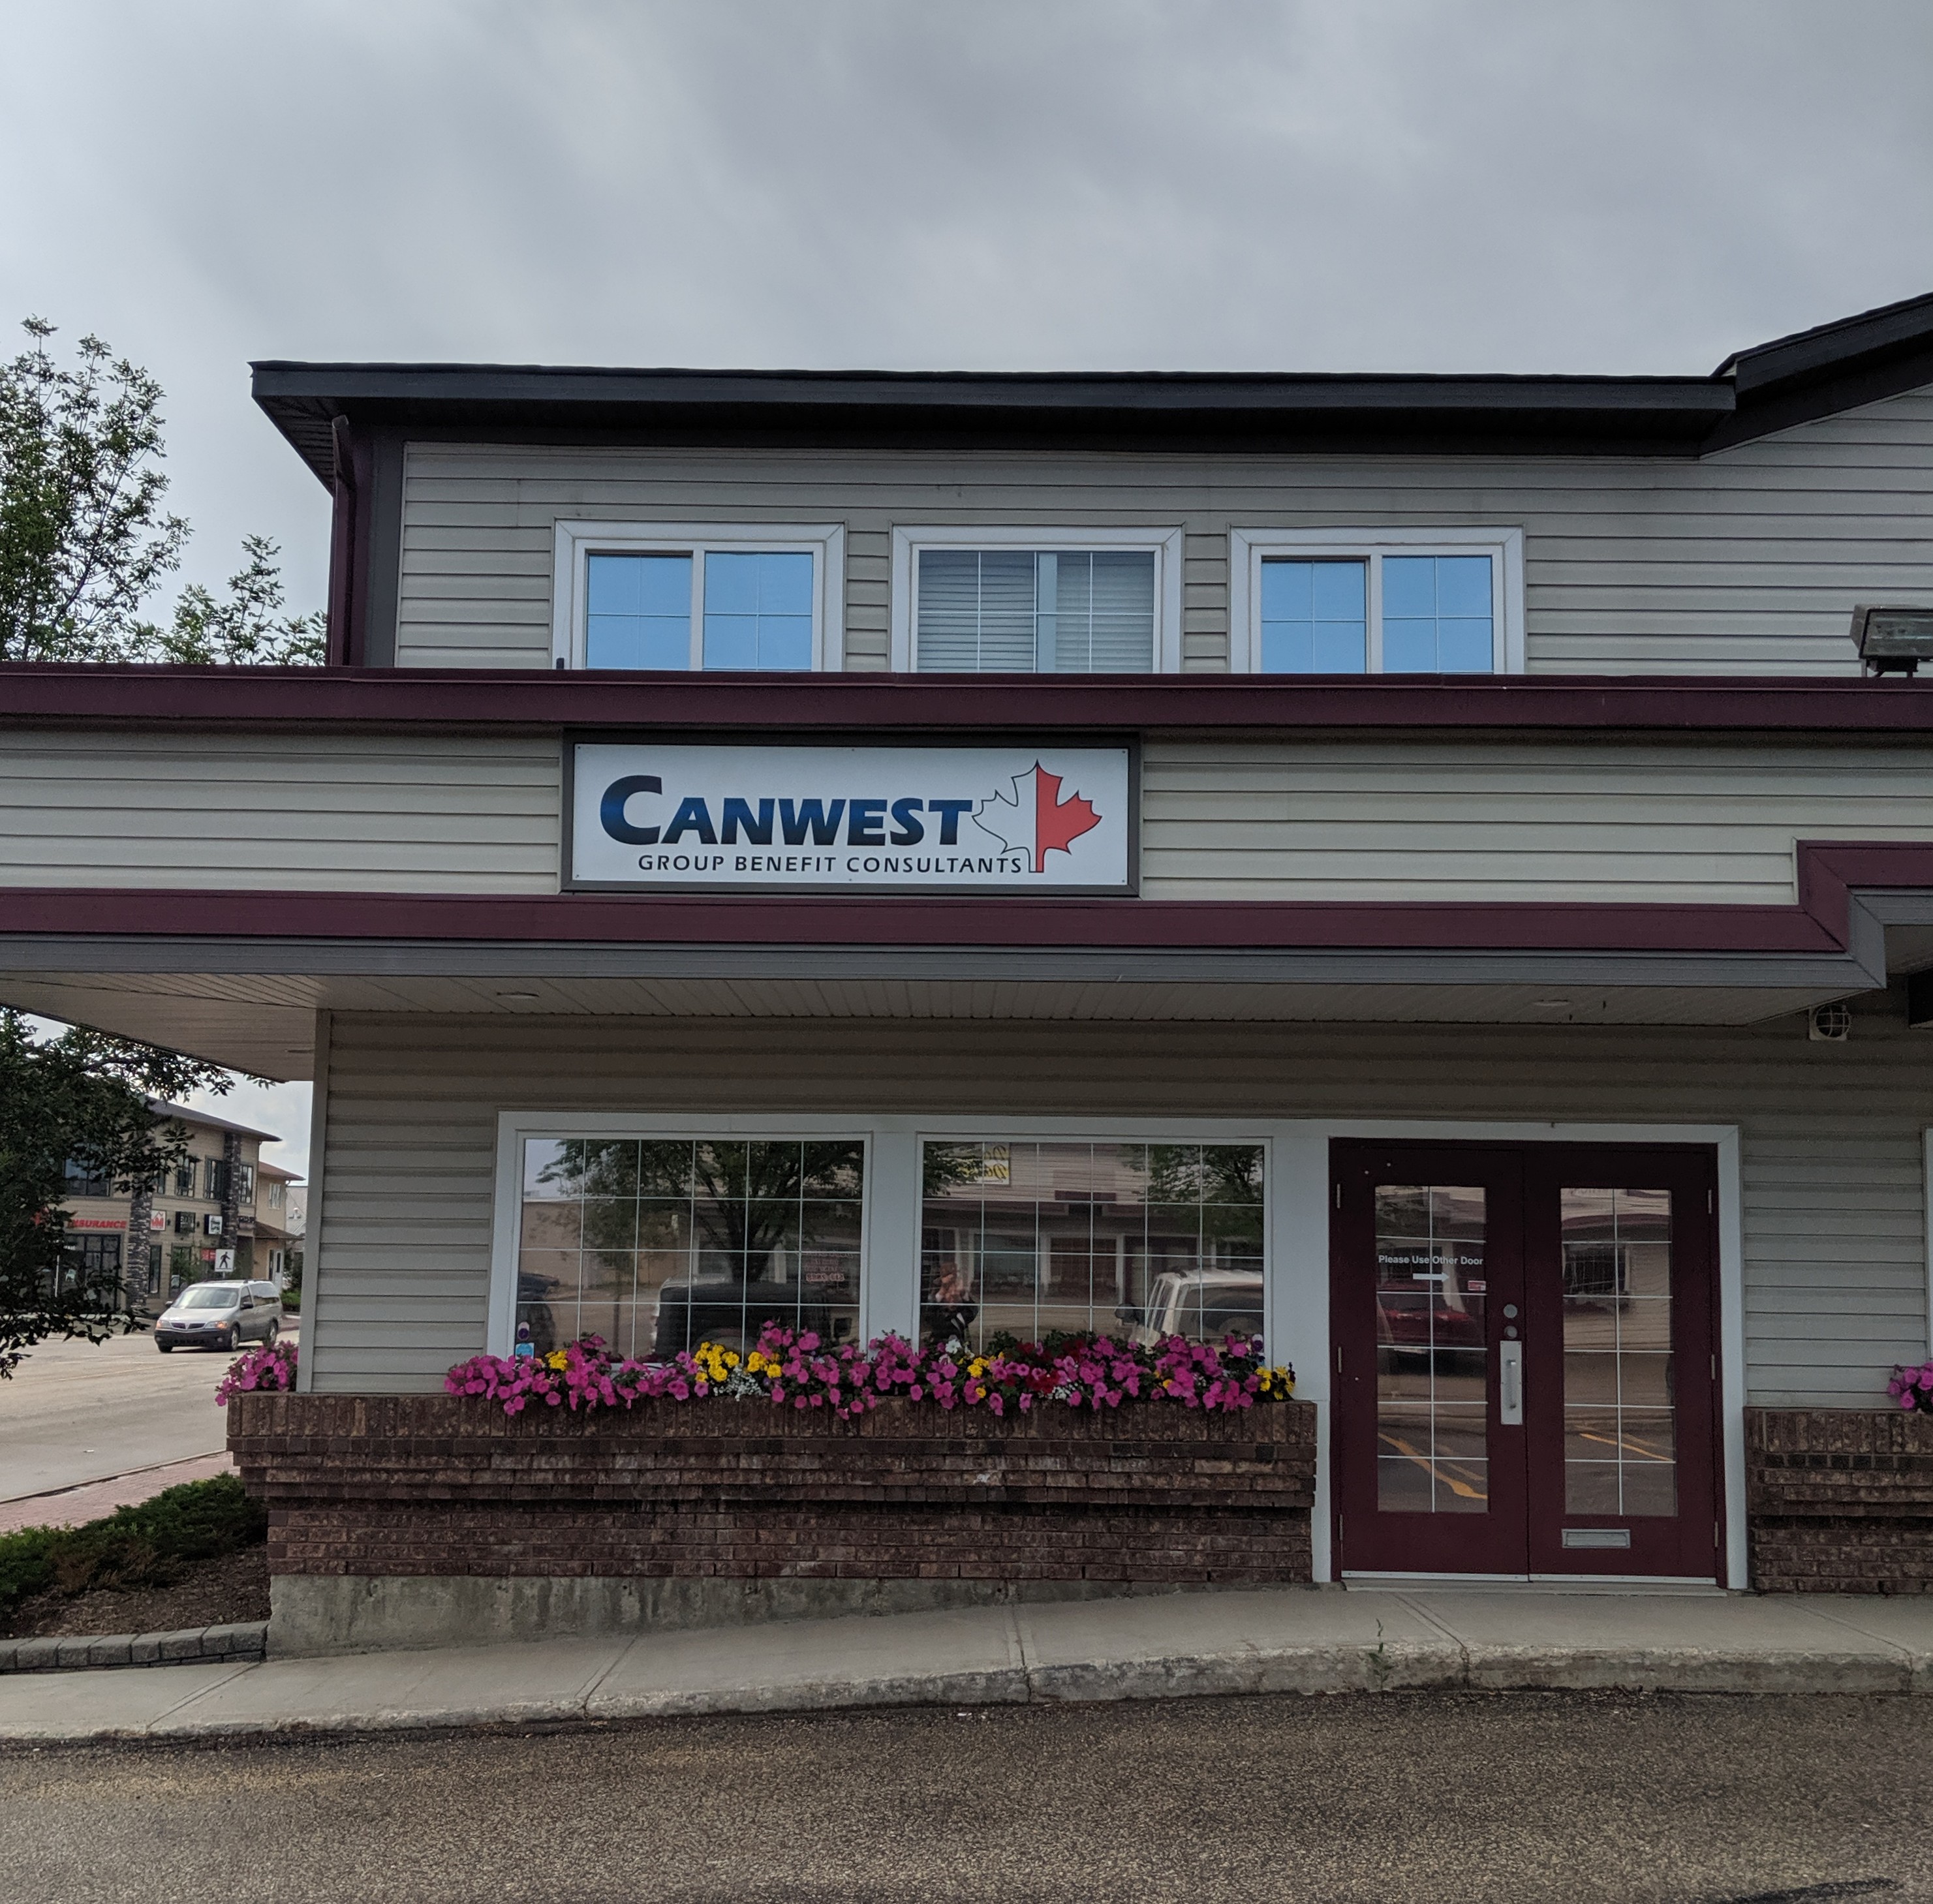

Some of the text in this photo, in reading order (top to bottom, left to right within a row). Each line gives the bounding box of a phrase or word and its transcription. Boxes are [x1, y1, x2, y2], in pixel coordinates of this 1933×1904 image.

[638, 855, 1021, 873] GROUP BENEFIT CONSULTANTS
[1378, 1255, 1483, 1265] Please Use Other Door
